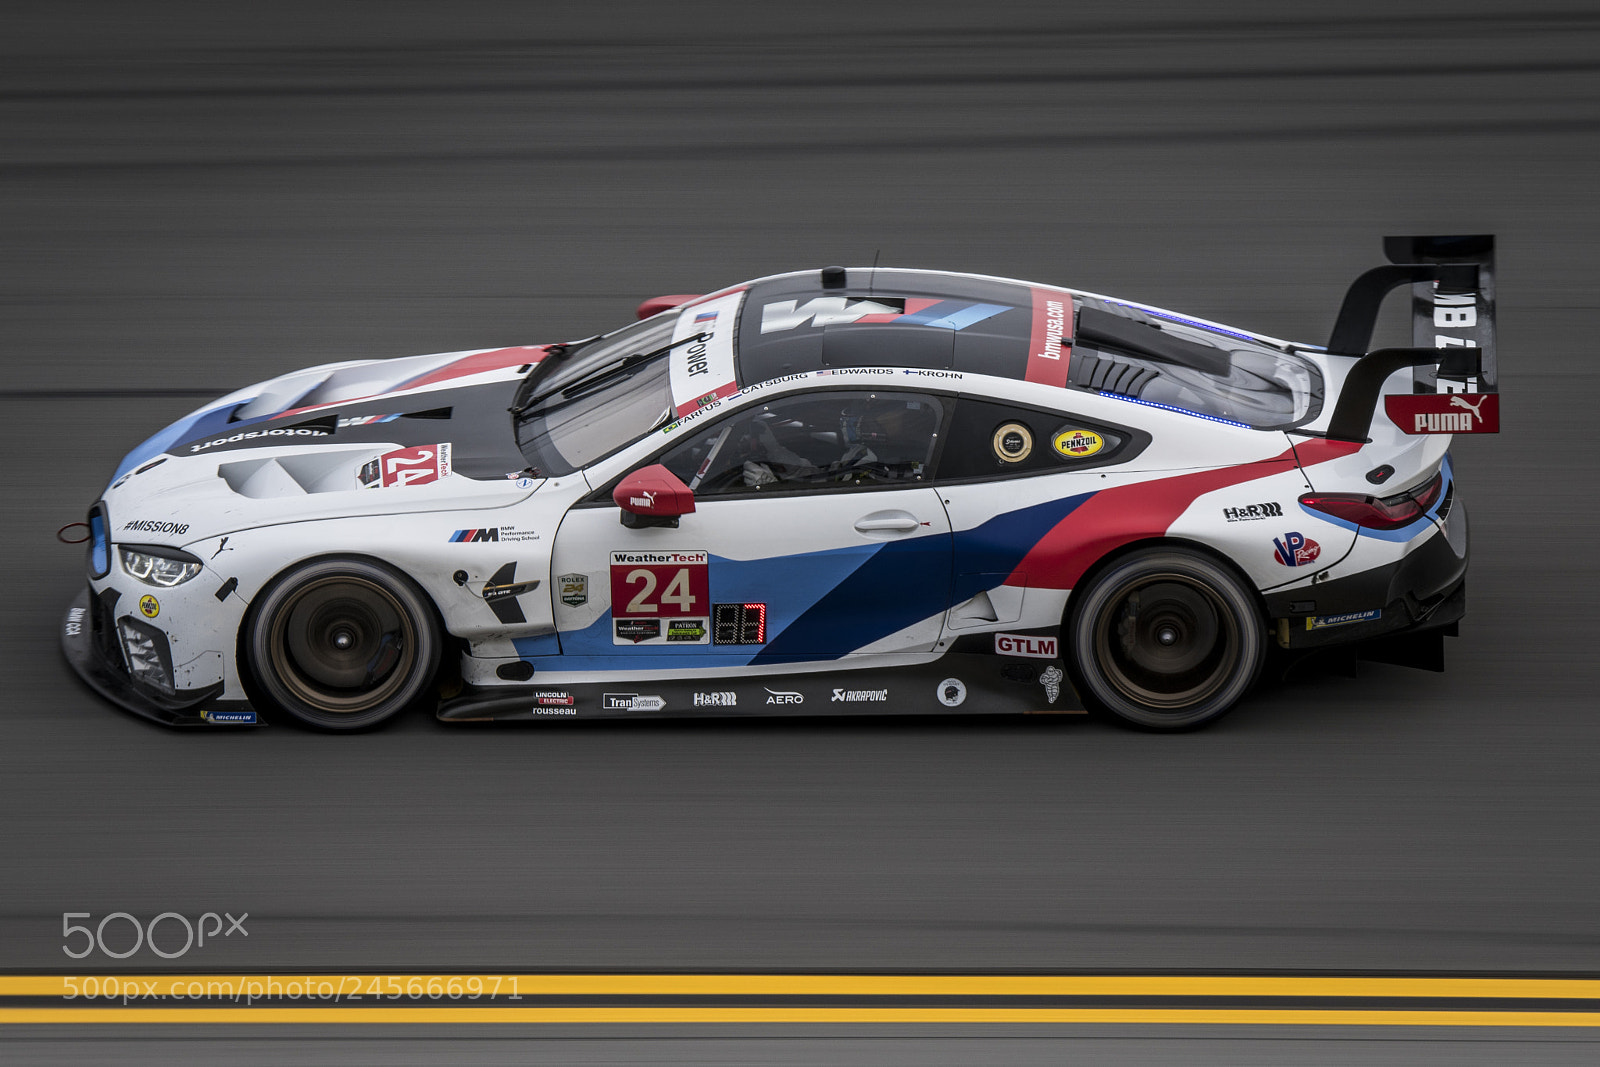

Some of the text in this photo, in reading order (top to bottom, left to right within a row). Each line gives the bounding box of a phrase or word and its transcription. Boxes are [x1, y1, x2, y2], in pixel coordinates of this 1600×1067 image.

[1037, 301, 1064, 361] bmwusa.com
[686, 332, 715, 377] Power
[677, 368, 963, 427] FARFUS CATSBURG EDWARDS KROHN
[1414, 412, 1473, 432] PUMA
[1061, 436, 1097, 450] PENNZOIL
[386, 450, 435, 487] 24
[440, 444, 449, 477] WeatherTech
[630, 497, 651, 507] PUMA
[123, 520, 190, 535] #MISSION8
[1272, 531, 1305, 567] VP
[614, 553, 703, 563] WeatherTech
[563, 584, 584, 592] 24
[625, 568, 696, 613] 24
[1328, 611, 1375, 624] MICHELIN
[998, 638, 1055, 655] GTLM
[766, 696, 804, 705] AERO
[532, 707, 577, 715] rousseau
